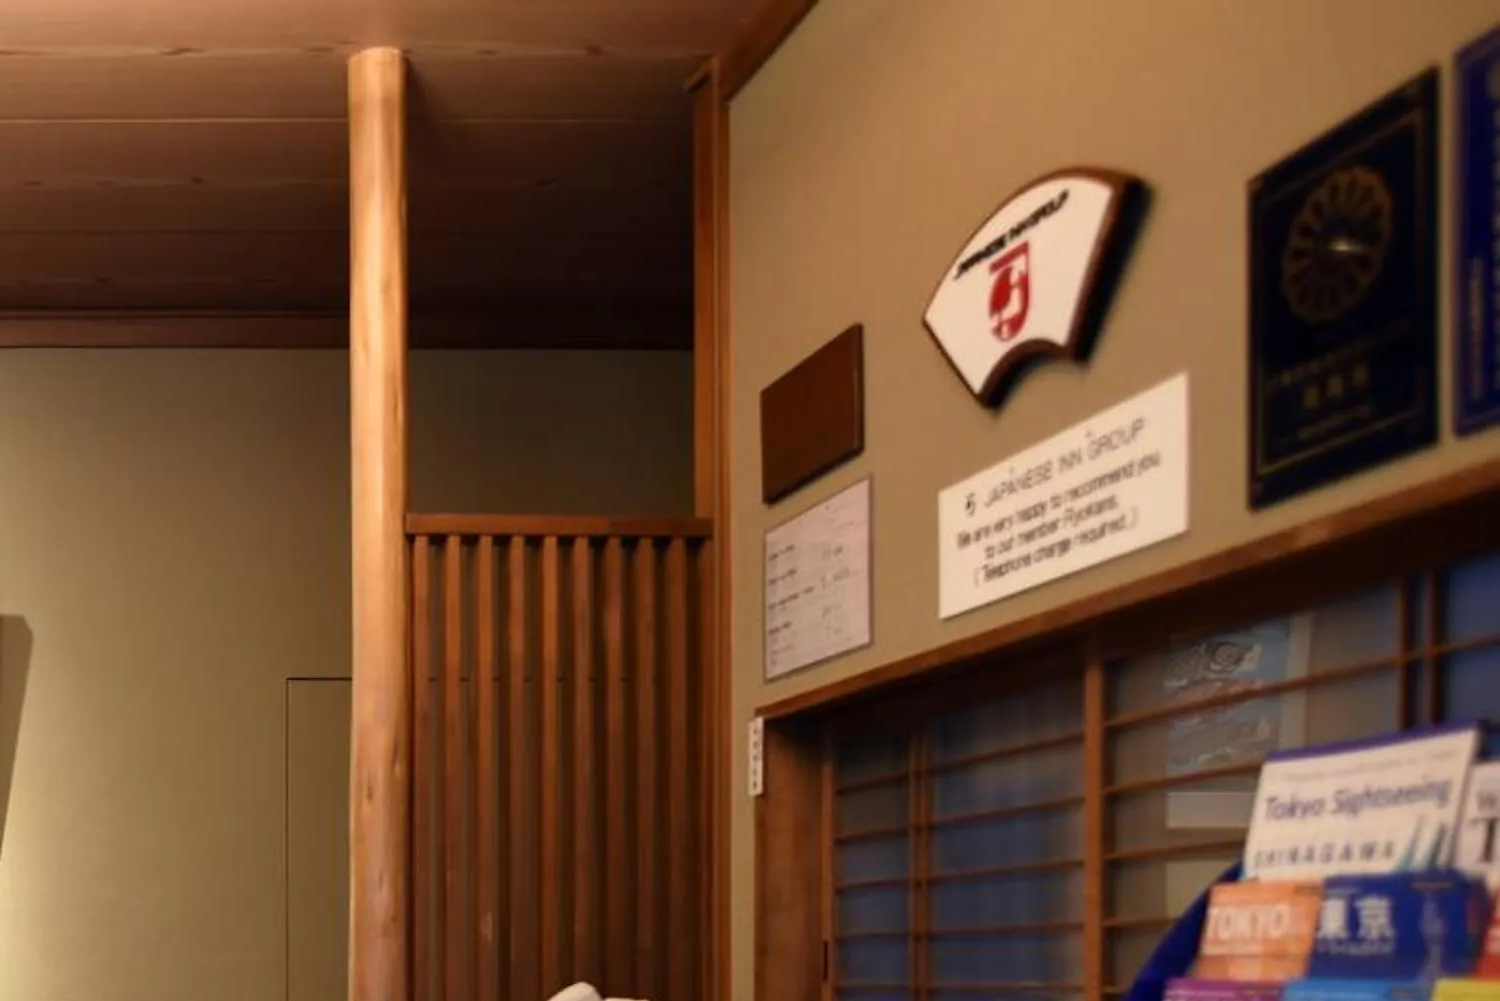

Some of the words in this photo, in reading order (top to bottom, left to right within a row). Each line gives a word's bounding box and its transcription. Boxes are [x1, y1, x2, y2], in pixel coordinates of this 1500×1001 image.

[984, 460, 1054, 507] JAPANESE
[1057, 448, 1083, 473] INN
[1087, 417, 1146, 461] GROUP
[1265, 796, 1325, 822] Tokyo
[1209, 904, 1291, 940] TOKYO
